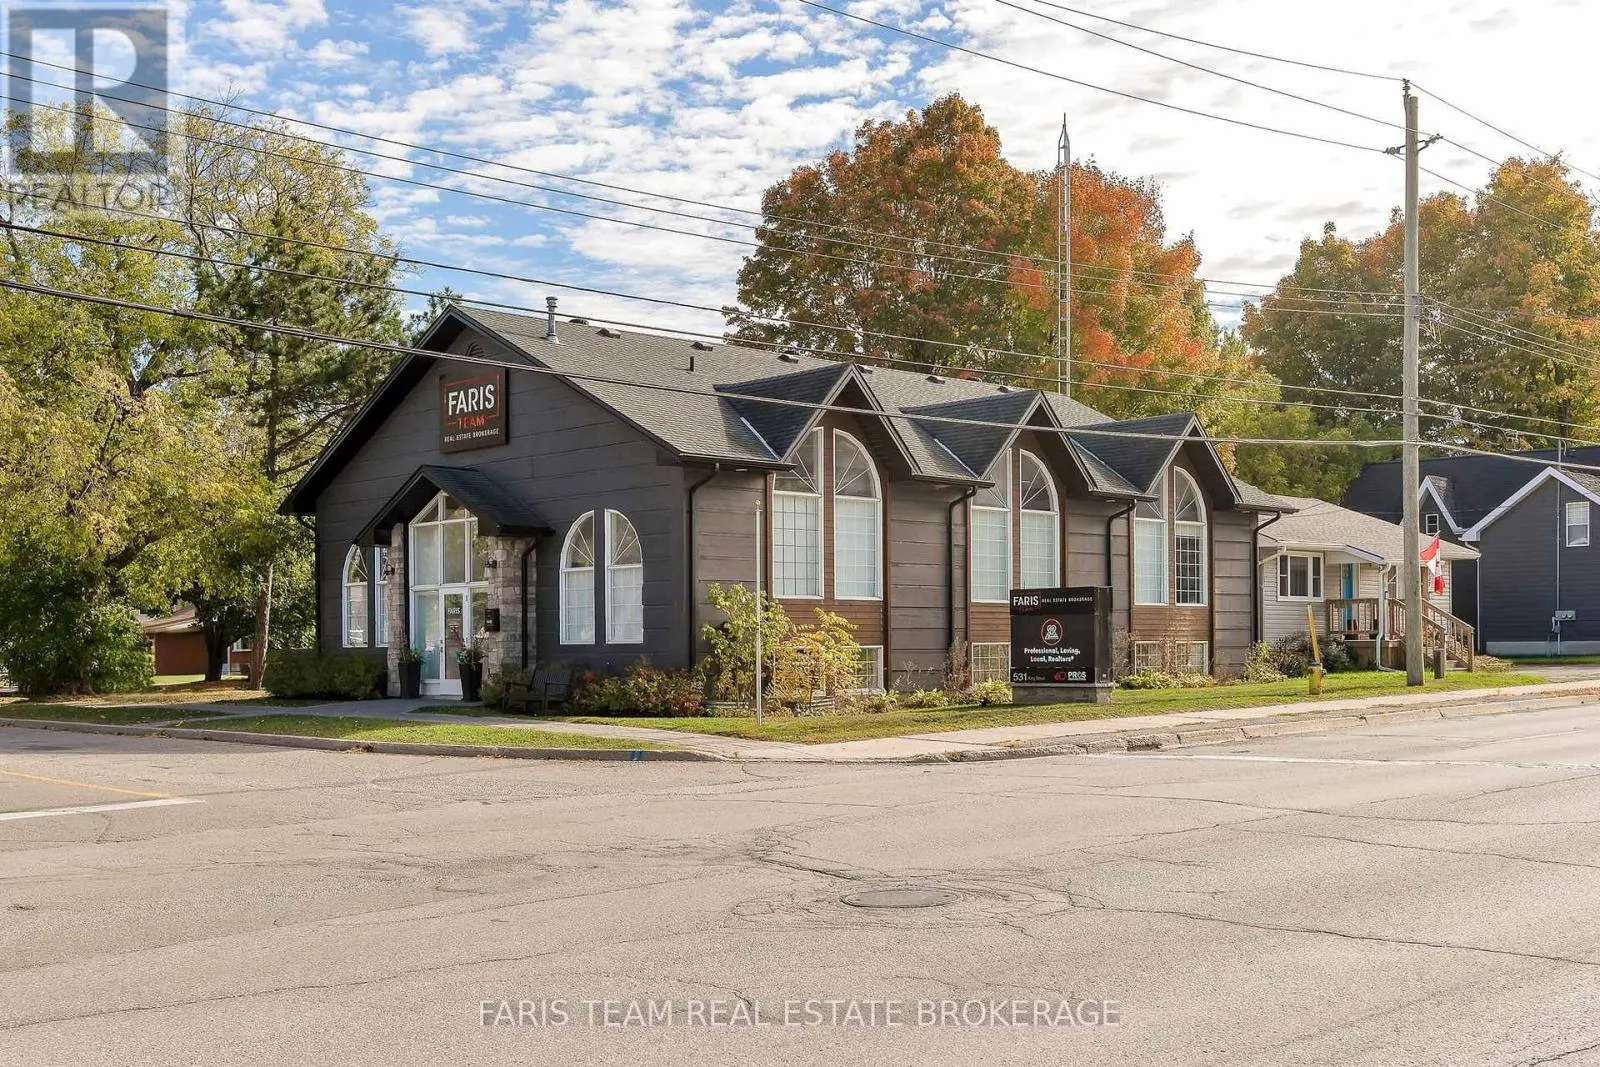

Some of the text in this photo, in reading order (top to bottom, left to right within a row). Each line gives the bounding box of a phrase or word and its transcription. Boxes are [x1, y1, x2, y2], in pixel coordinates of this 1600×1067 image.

[448, 384, 495, 415] FARIS
[459, 416, 485, 429] TEAM
[444, 428, 499, 442] REAL ESTATE BROKERAGE
[1013, 595, 1039, 606] FARIS
[1013, 672, 1027, 681] 531
